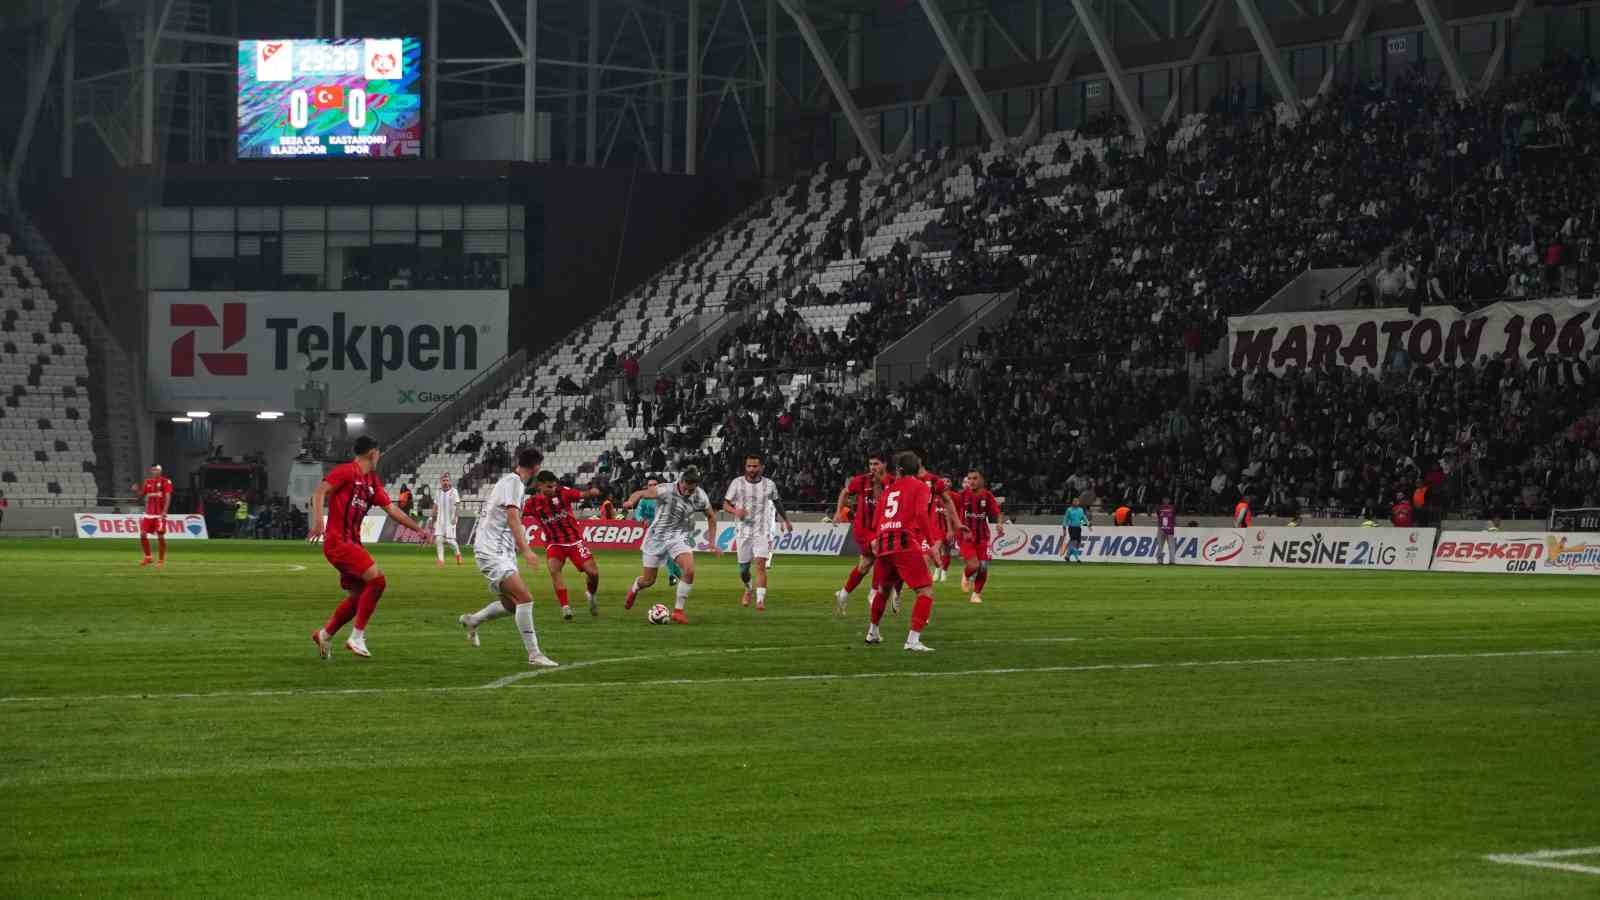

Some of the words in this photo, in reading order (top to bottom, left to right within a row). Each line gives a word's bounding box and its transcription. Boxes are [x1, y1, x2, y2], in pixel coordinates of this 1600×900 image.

[290, 89, 308, 129] 0
[348, 89, 366, 129] 0
[329, 135, 387, 145] KASTAMONU
[344, 144, 370, 154] SPOR
[266, 311, 478, 384] Tekpen
[1231, 317, 1488, 371] MARATON
[884, 491, 901, 519] 5
[583, 525, 644, 544] KEBAP
[1506, 560, 1537, 572] GIDA
